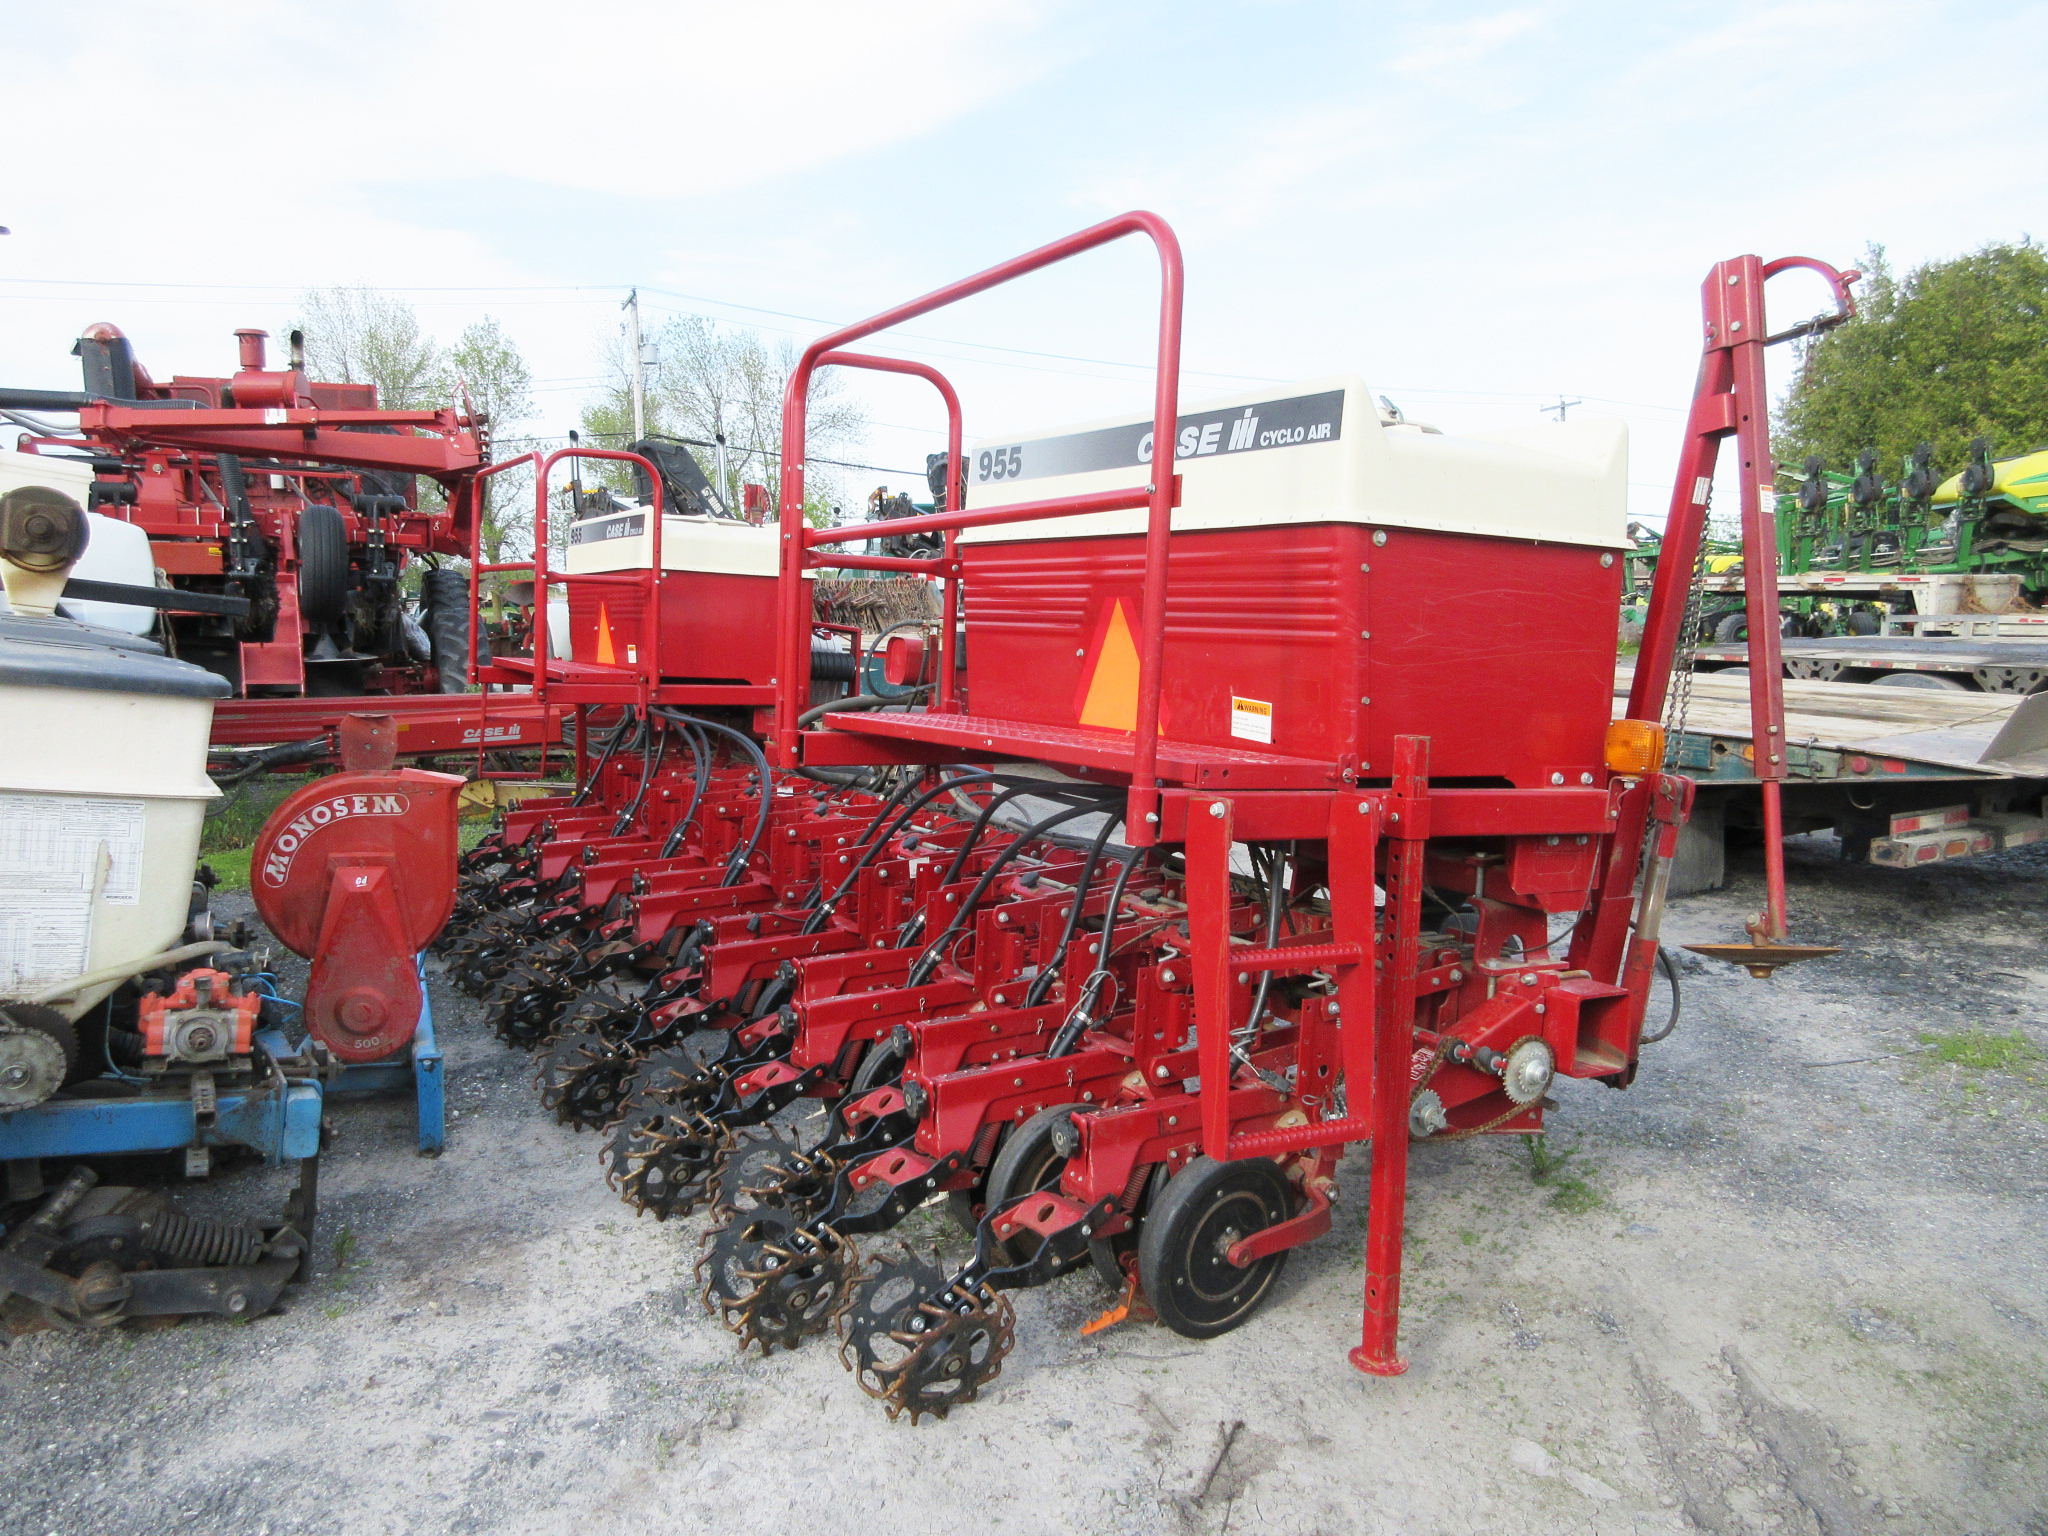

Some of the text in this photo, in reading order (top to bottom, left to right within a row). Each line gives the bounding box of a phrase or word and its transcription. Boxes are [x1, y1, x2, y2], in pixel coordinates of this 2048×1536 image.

[979, 445, 1022, 482] 955
[1137, 422, 1223, 463] CSE
[1260, 426, 1305, 447] CYCLO
[1307, 423, 1331, 441] AIR
[570, 527, 583, 545] 955
[606, 523, 624, 539] CASE
[1243, 704, 1267, 715] WARNING
[266, 796, 402, 883] MONOSEM
[354, 1036, 380, 1049] 500
